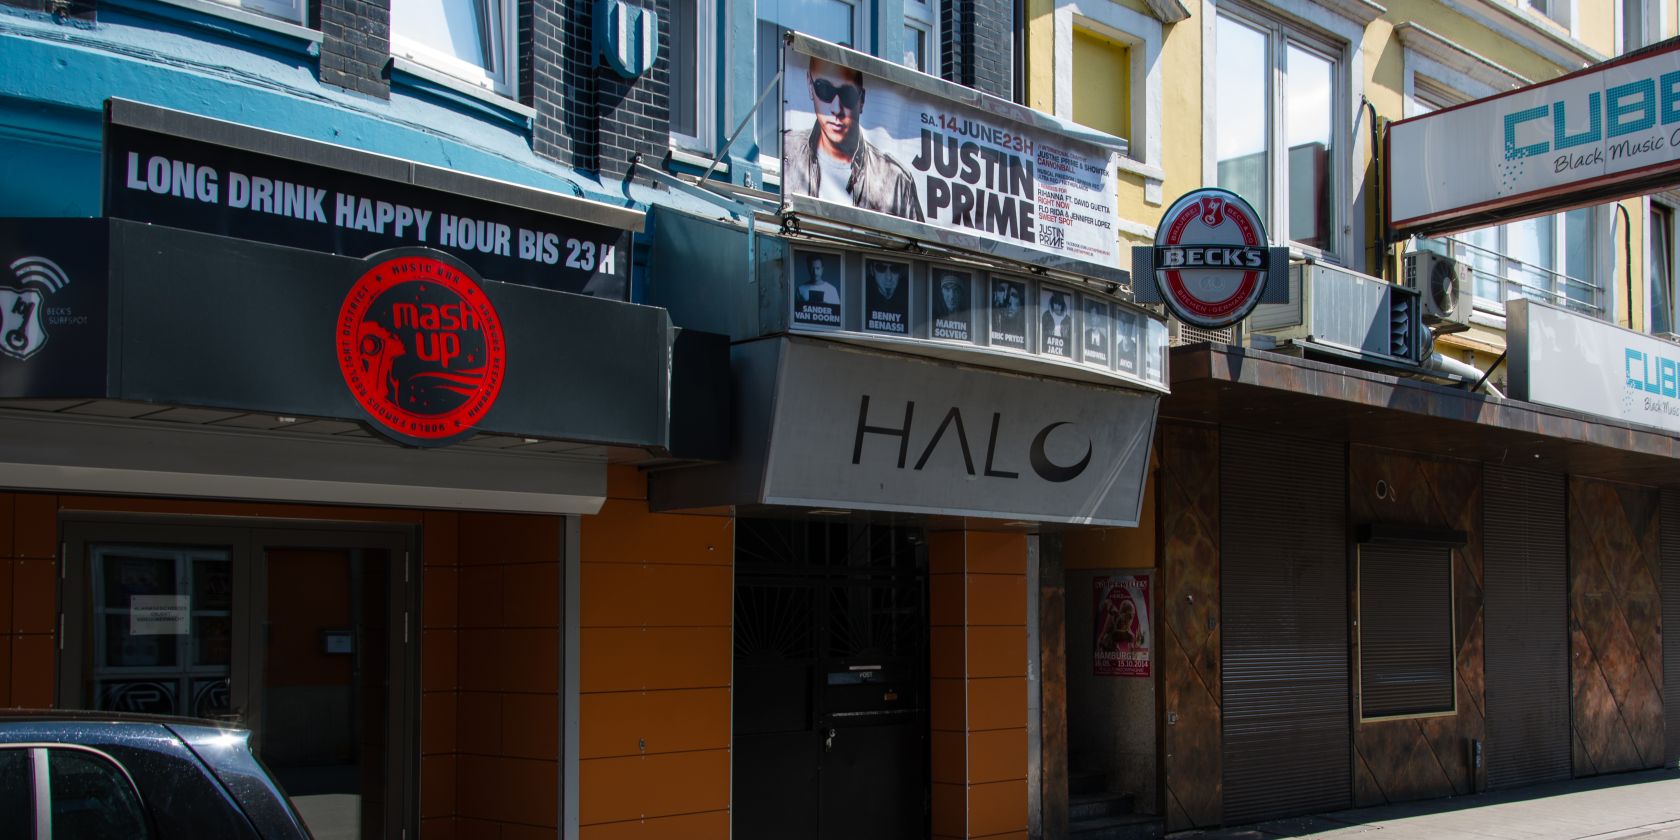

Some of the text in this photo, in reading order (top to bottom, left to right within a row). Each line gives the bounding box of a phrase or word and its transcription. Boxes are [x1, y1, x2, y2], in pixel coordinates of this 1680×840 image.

[1554, 148, 1604, 174] Black
[1609, 135, 1664, 161] Music
[912, 128, 1034, 201] JUSTIN
[927, 175, 1035, 243] PRIME
[1038, 188, 1064, 201] RIHANNA
[1074, 198, 1089, 208] DAVID
[1090, 203, 1110, 214] GUETTA
[1038, 197, 1070, 210] RIGHT NOW
[126, 151, 615, 275] LONG DRINK HAPPY HOUR BIS 23 H
[1039, 205, 1049, 213] FLO
[1050, 207, 1064, 217] RIDA
[1070, 212, 1094, 225] JENNIFER
[1095, 218, 1110, 229] LOPEZ
[1039, 213, 1073, 227] SWEET SPOT
[1040, 224, 1064, 238] JUSTIN
[1171, 206, 1199, 241] BRAUEREI
[1227, 208, 1245, 227] BECK
[1039, 233, 1064, 248] PRIME
[1163, 246, 1262, 267] BECK'S
[392, 263, 460, 283] MUSIC BAR
[1177, 289, 1246, 313] BREMEN GERMANY
[47, 306, 72, 316] BECK'S
[342, 285, 369, 337] DISTRICT
[392, 301, 480, 331] mash
[795, 311, 840, 322] VAN DOORN
[803, 305, 832, 315] SANDER
[872, 311, 901, 322] BENNY
[869, 320, 904, 333] BENASSI
[936, 319, 967, 331] MARTIN
[934, 328, 968, 340] SOLVEIG
[992, 331, 1024, 344] ERIC PRYDZ
[1047, 337, 1064, 346] AFRO
[415, 331, 461, 368] up
[1048, 345, 1063, 356] JACK
[341, 341, 367, 397] REDLIGHT
[1625, 348, 1680, 400] CUB
[1662, 401, 1680, 417] Music
[411, 423, 445, 432] WORLD
[852, 395, 1093, 483] HALO
[1094, 651, 1131, 660] HAMBURG
